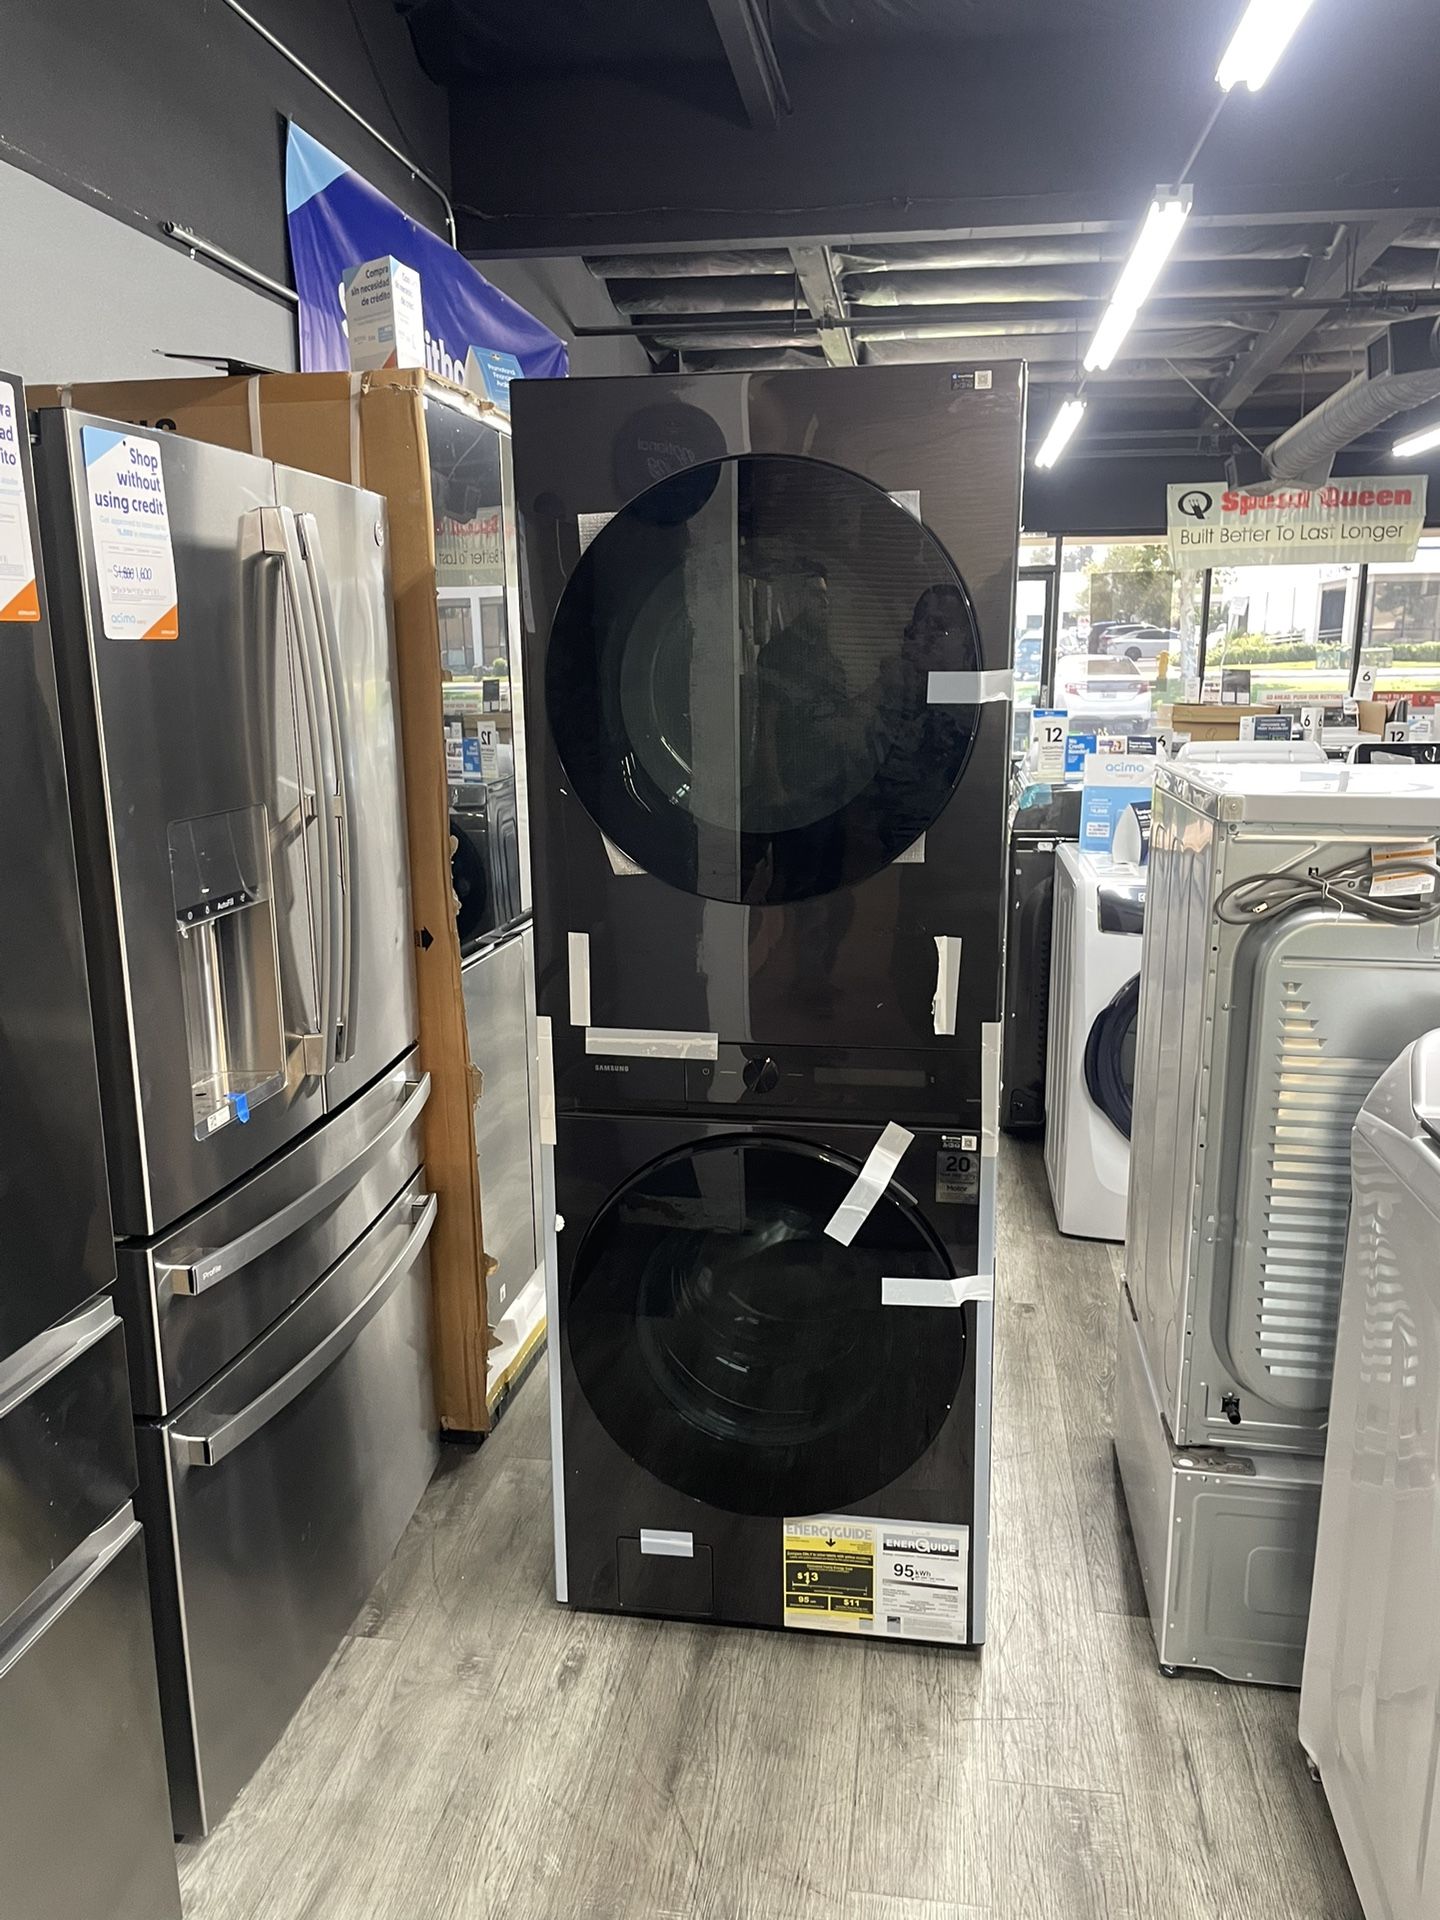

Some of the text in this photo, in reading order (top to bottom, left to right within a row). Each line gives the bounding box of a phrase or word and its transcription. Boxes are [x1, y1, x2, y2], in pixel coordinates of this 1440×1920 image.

[366, 265, 389, 279] Compra
[351, 279, 390, 296] sin necesidad
[361, 297, 369, 306] de
[130, 447, 158, 472] Shop
[117, 470, 162, 492] without
[95, 491, 165, 515] using credit
[1321, 485, 1413, 508] Queen
[1181, 523, 1404, 545] Built Better To Last Longer
[1362, 671, 1371, 682] 6
[1304, 714, 1311, 727] 6
[1045, 727, 1063, 743] 12
[1390, 731, 1405, 742] 12
[1105, 762, 1145, 772] acima
[594, 1064, 630, 1072] SAMSUNG
[946, 1155, 971, 1172] 20
[785, 1524, 873, 1540] ENERGYGUIDE
[797, 1571, 819, 1582] $13
[893, 1563, 931, 1577] 95 kWh
